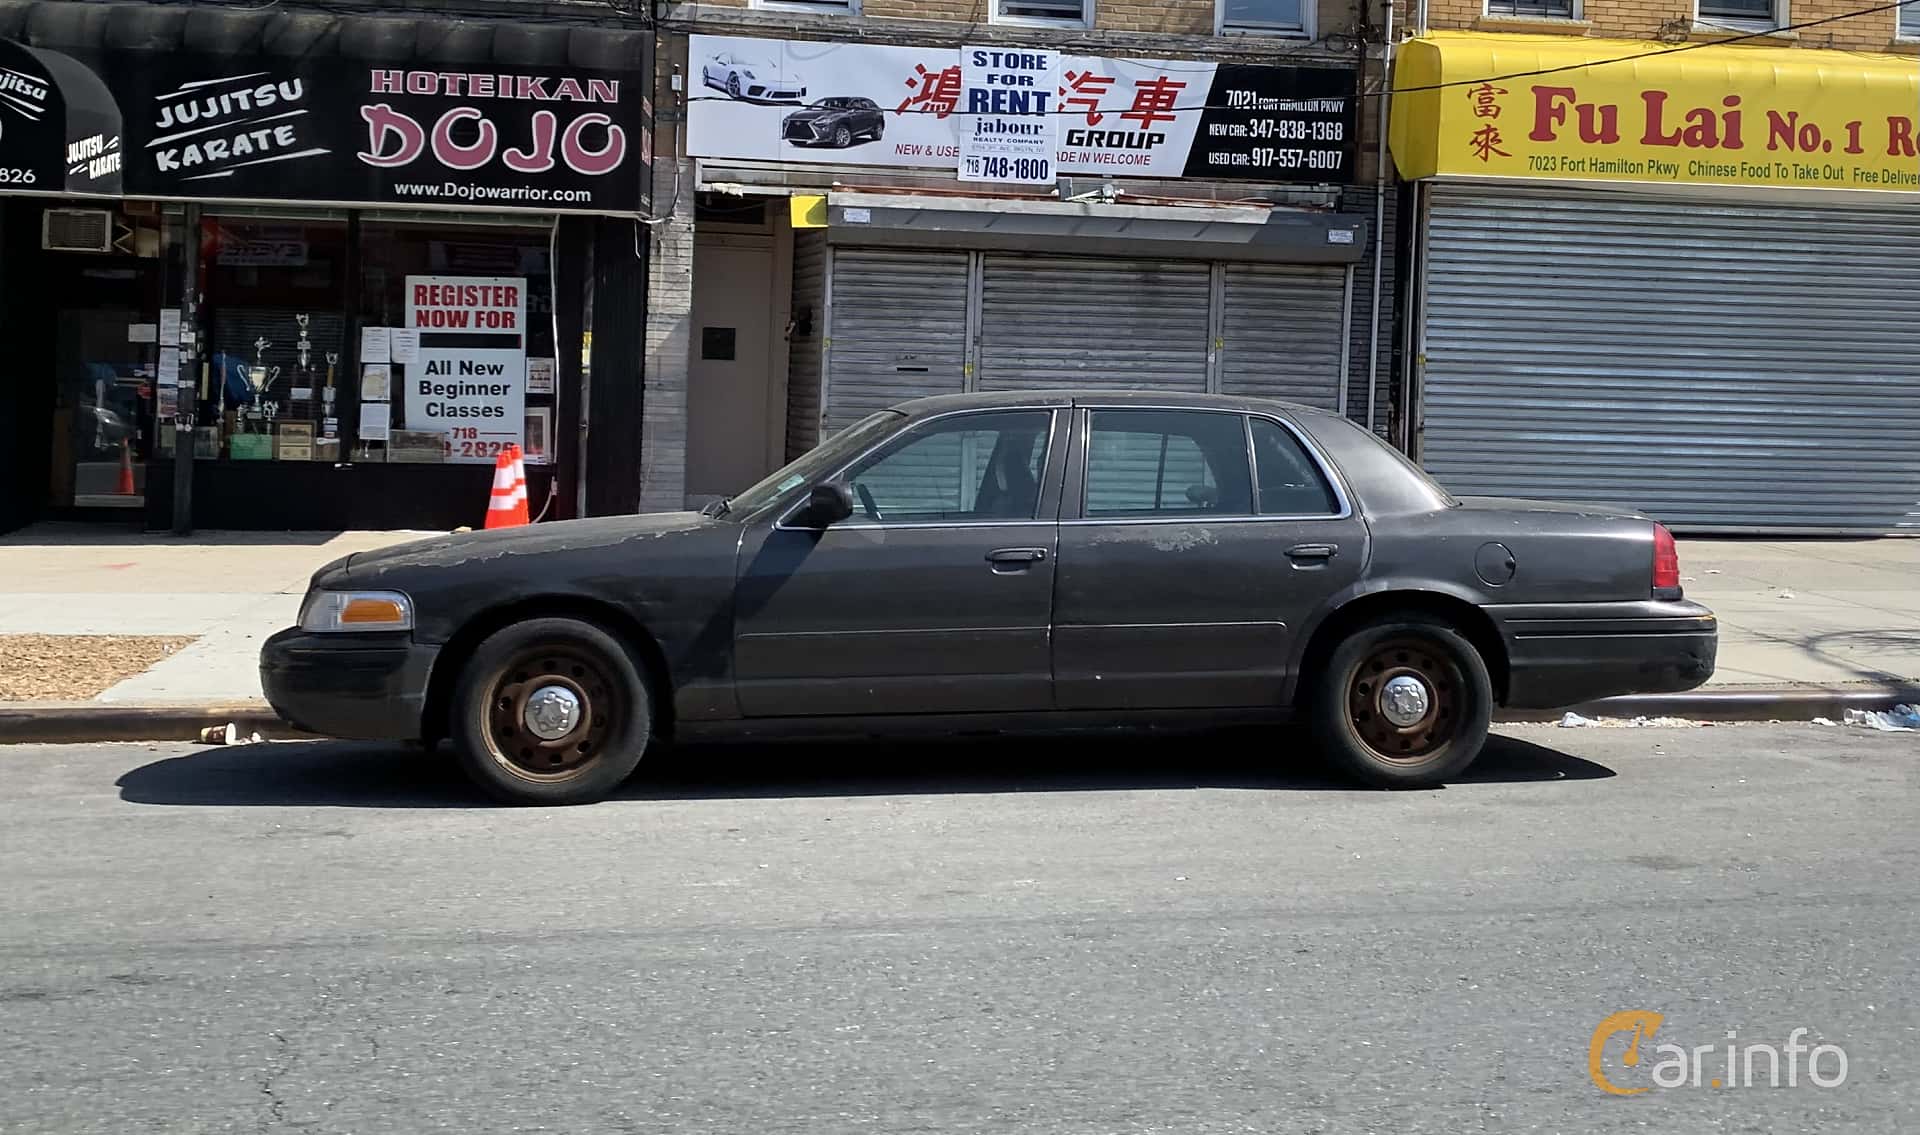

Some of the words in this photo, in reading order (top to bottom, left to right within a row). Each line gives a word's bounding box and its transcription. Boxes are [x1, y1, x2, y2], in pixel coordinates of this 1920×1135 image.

[973, 51, 1047, 70] STORE
[0, 73, 47, 100] jitsu
[370, 69, 619, 103] HOTEIKAN
[987, 74, 1034, 86] FOR
[155, 78, 304, 128] JUJITSU
[895, 64, 961, 119] 鴻
[1058, 70, 1187, 129] 汽車
[968, 88, 1051, 117] RENT
[1226, 90, 1257, 109] 7021
[1259, 98, 1278, 110] FORT
[1321, 100, 1344, 112] PKWY
[975, 117, 1043, 137] jabour
[1209, 123, 1227, 136] NEW
[1229, 124, 1248, 137] CAR:
[1249, 119, 1343, 140] 347-838-1368
[1467, 83, 1512, 162] 富來
[1528, 85, 1620, 144] Fu
[1640, 90, 1744, 149] Lai
[1766, 111, 1833, 153] No.
[1843, 121, 1864, 154] 1
[1886, 116, 1920, 157] R
[67, 133, 103, 164] JUJITSU
[155, 125, 297, 172] KARATE
[357, 103, 626, 175] DOJO
[1066, 129, 1165, 150] GROUP
[895, 144, 923, 155] NEW
[925, 145, 933, 156] &
[1078, 152, 1091, 163] IN
[1094, 153, 1151, 165] WELCOME
[1209, 152, 1230, 165] USED
[1231, 153, 1250, 165] CAR:
[1252, 147, 1343, 169] 917-557-6007
[89, 152, 120, 180] KARATE
[966, 159, 980, 173] 718
[1528, 156, 1557, 171] 7023
[1560, 156, 1585, 172] Fort
[1589, 157, 1643, 174] Hamilton
[1648, 160, 1680, 179] Pkwy
[1688, 160, 1737, 177] Chinese
[1741, 162, 1771, 178] Food
[1775, 163, 1789, 178] To
[1792, 164, 1820, 180] Take
[1823, 165, 1845, 180] Out
[1853, 167, 1879, 182] Free
[394, 182, 592, 202] www.Dojowarrior.com
[414, 285, 518, 307] REGISTER
[416, 310, 469, 328] NOW
[475, 311, 516, 328] FOR
[425, 360, 451, 376] All
[459, 361, 504, 376] New
[419, 380, 511, 399] Beginner
[426, 402, 505, 418] Classes
[452, 427, 477, 439] 718
